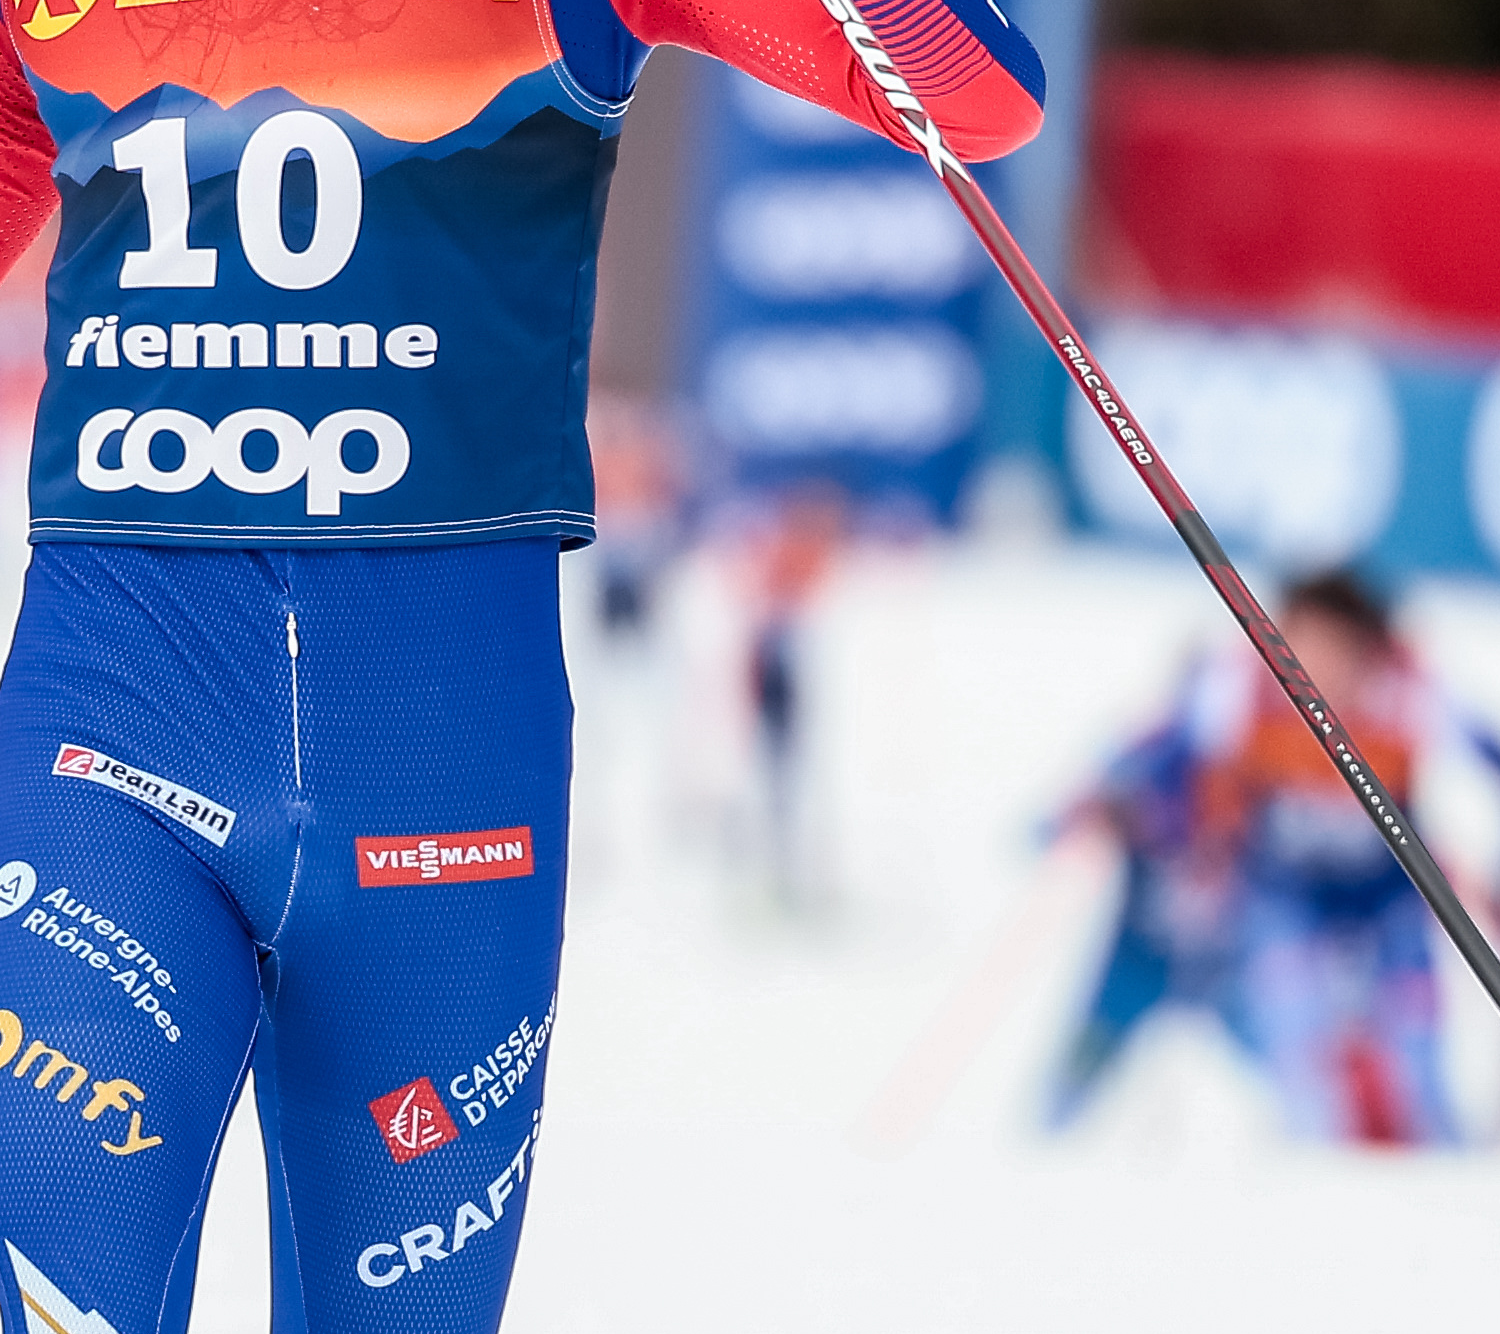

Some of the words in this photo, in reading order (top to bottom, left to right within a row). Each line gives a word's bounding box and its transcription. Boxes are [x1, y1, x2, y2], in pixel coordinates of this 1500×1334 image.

[112, 109, 364, 291] 10
[65, 314, 440, 368] fiemme
[1058, 334, 1102, 389] TRIAC
[1111, 415, 1153, 465] AERO
[77, 407, 412, 516] coop
[93, 759, 163, 798] Jean
[165, 792, 230, 833] Lain
[1336, 741, 1409, 846] TECHNOLOGY
[365, 840, 524, 879] VIESSMANN
[20, 907, 182, 1043] Rhône-Alpes
[41, 886, 178, 994] Auvergne-
[450, 1015, 533, 1101] CAISSE
[356, 1134, 531, 1289] CRAFT
